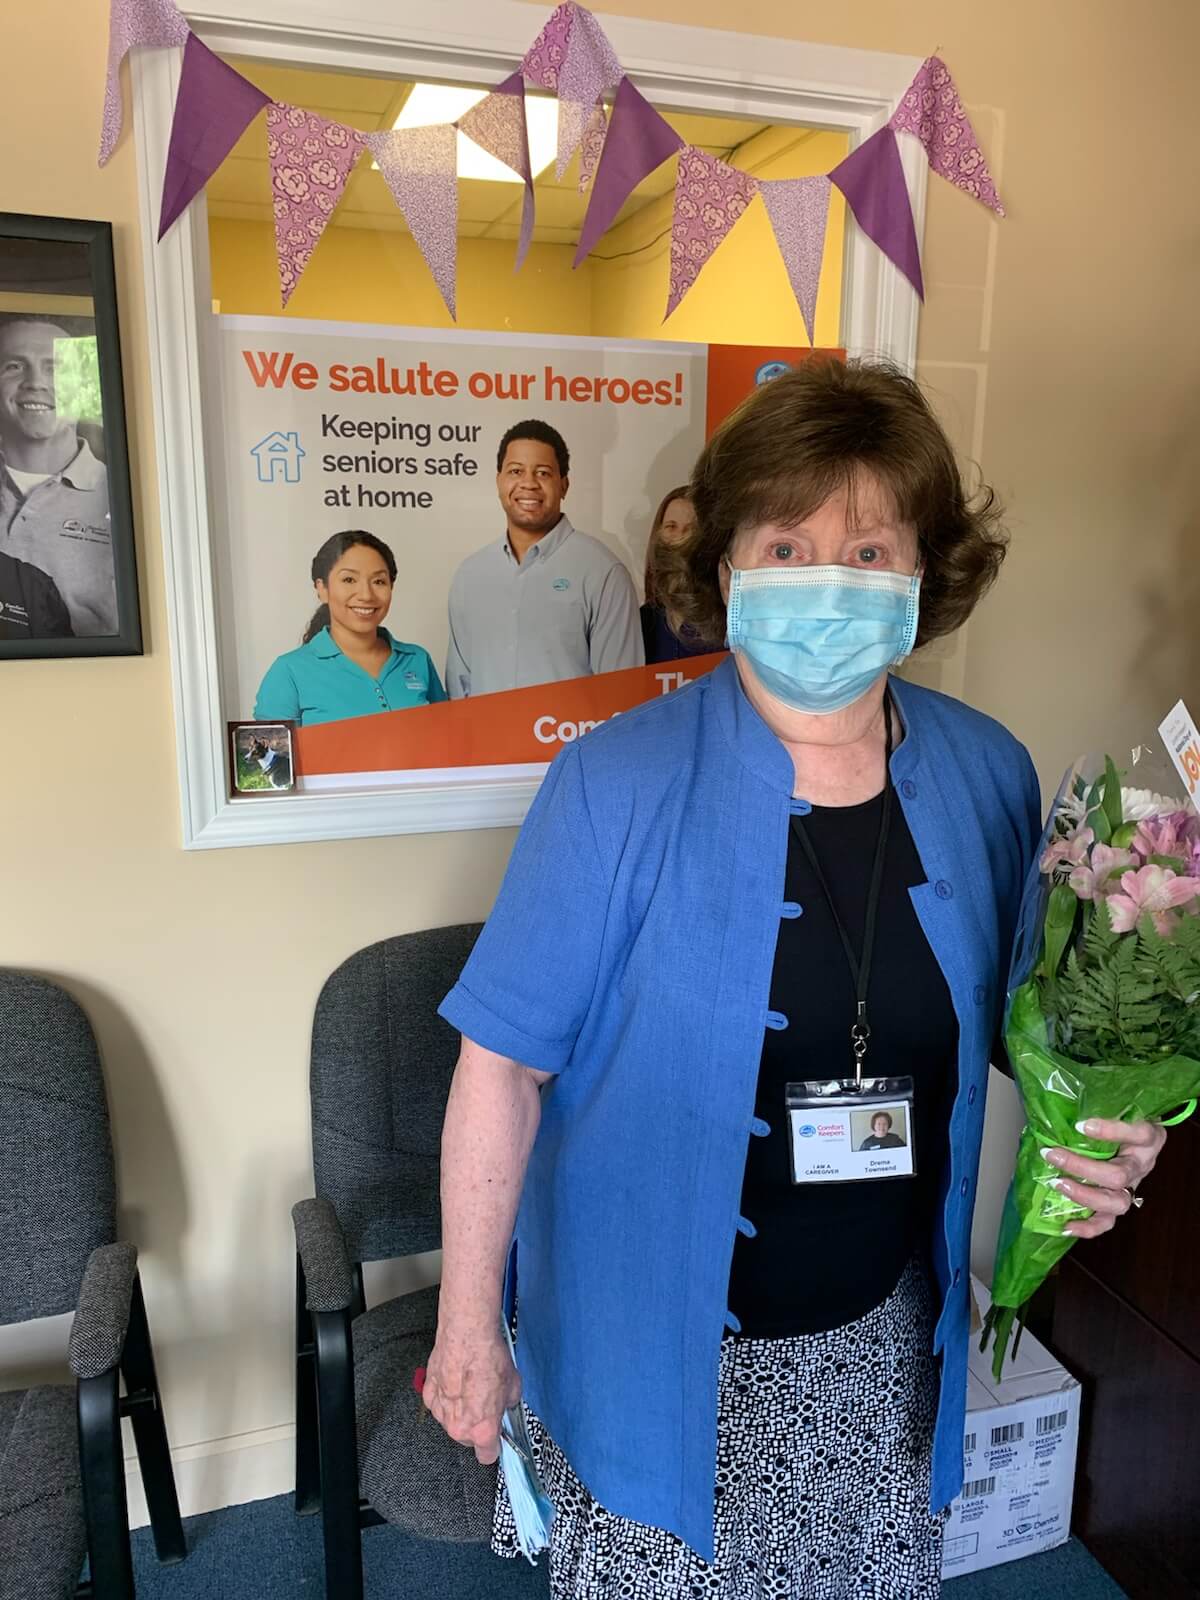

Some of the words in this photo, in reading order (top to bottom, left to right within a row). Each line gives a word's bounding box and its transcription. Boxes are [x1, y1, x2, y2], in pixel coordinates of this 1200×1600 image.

[242, 351, 319, 390] We
[328, 356, 459, 398] salute
[468, 370, 536, 401] our
[543, 366, 684, 406] heroes!
[321, 413, 431, 448] Keeping
[438, 424, 482, 443] our
[322, 450, 418, 475] seniors
[424, 452, 478, 476] safe
[324, 485, 352, 507] at
[357, 484, 433, 509] home
[533, 712, 624, 744] Com
[817, 1124, 845, 1132] Comfort
[864, 1165, 897, 1173] Townsend
[990, 1446, 1013, 1457] SMALL
[961, 1499, 985, 1511] LARGE
[1033, 1513, 1060, 1530] Dental
